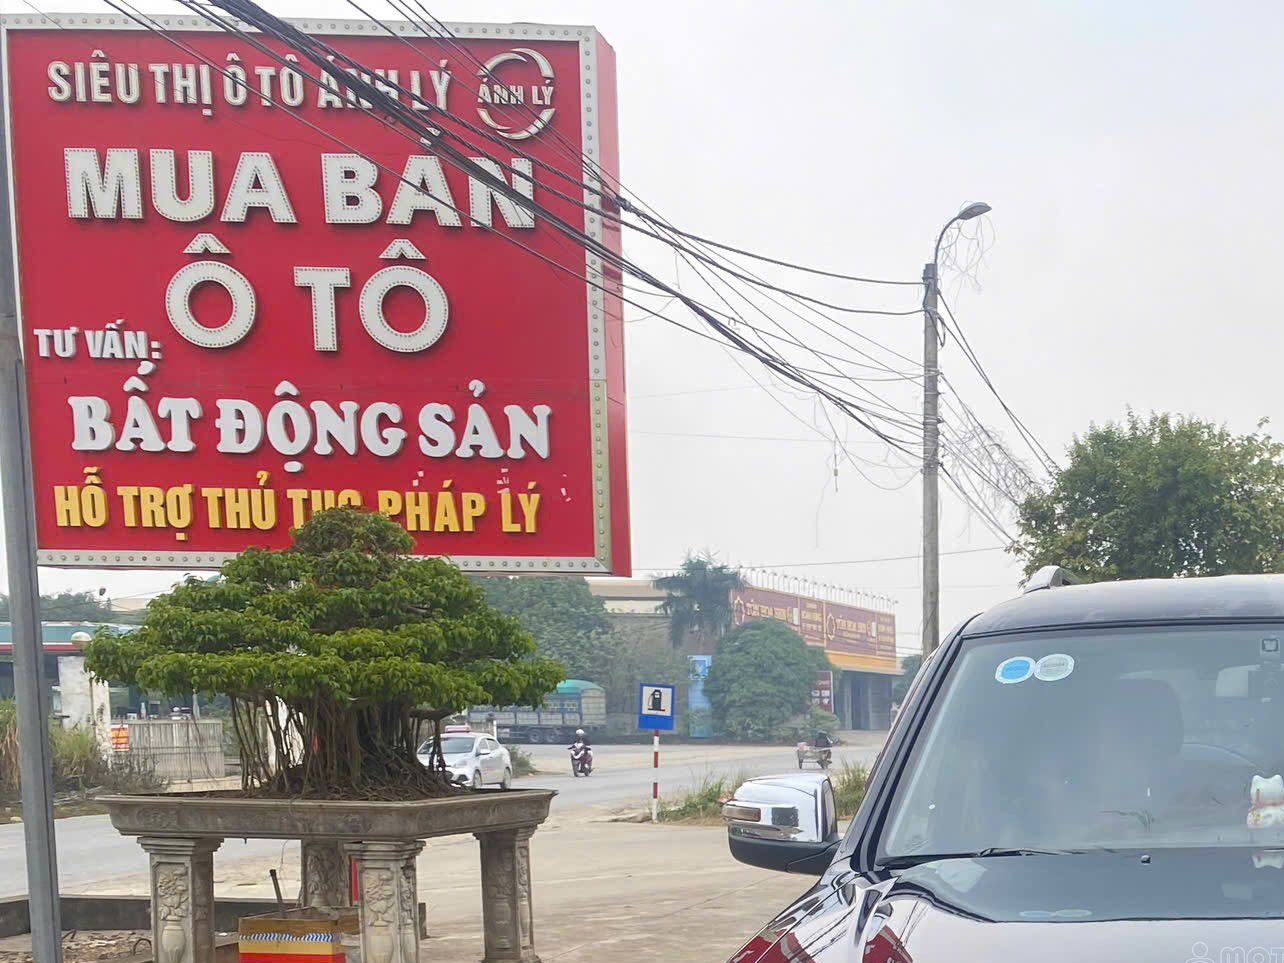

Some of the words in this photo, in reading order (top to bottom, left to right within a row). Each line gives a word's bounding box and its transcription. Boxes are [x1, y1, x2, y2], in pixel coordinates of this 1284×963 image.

[47, 49, 139, 104] SIÊU
[148, 63, 213, 116] THỊ
[222, 53, 249, 107] Ô
[254, 54, 305, 107] TÔ
[410, 59, 453, 112] LÝ
[477, 76, 525, 105] ÁNH
[532, 79, 555, 105] LÝ
[64, 147, 298, 224] MUA
[320, 126, 537, 229] BÁN
[165, 233, 257, 348] Ô
[293, 239, 449, 353] TÔ
[33, 326, 79, 358] TƯ
[84, 319, 162, 359] VẤN:
[67, 360, 203, 453] BẤT
[214, 380, 408, 473] ĐỘNG
[417, 379, 552, 460] SẢN
[53, 467, 107, 528] HỖ
[116, 483, 193, 541] TRỢ
[201, 470, 277, 531] THỦ
[377, 480, 487, 534] PHÁP
[502, 481, 541, 534] LÝ
